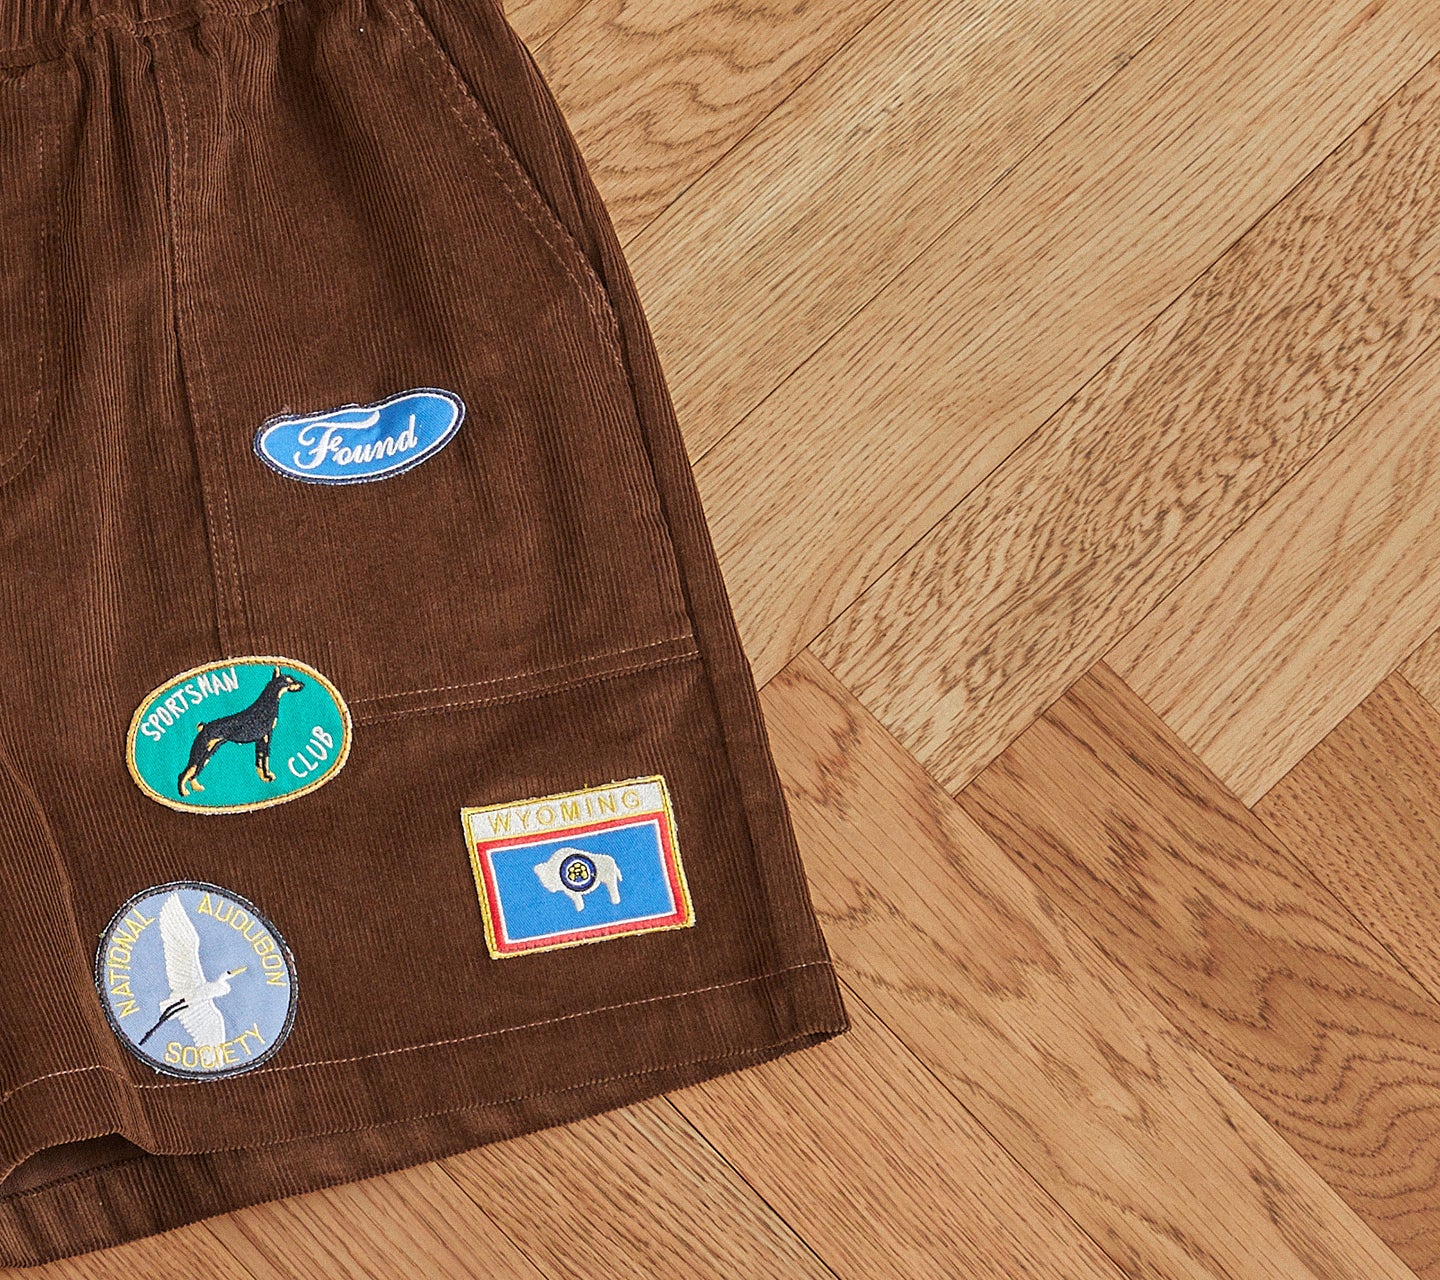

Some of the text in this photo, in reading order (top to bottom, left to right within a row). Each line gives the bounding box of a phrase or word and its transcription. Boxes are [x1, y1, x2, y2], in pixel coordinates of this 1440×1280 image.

[293, 410, 418, 469] Found
[140, 667, 239, 741] SPORTSMAN
[287, 725, 334, 778] CLUB
[487, 790, 642, 834] WYOMING
[107, 893, 287, 1018] NATIONAL AUDUBON
[164, 1022, 266, 1069] SOCIETY
